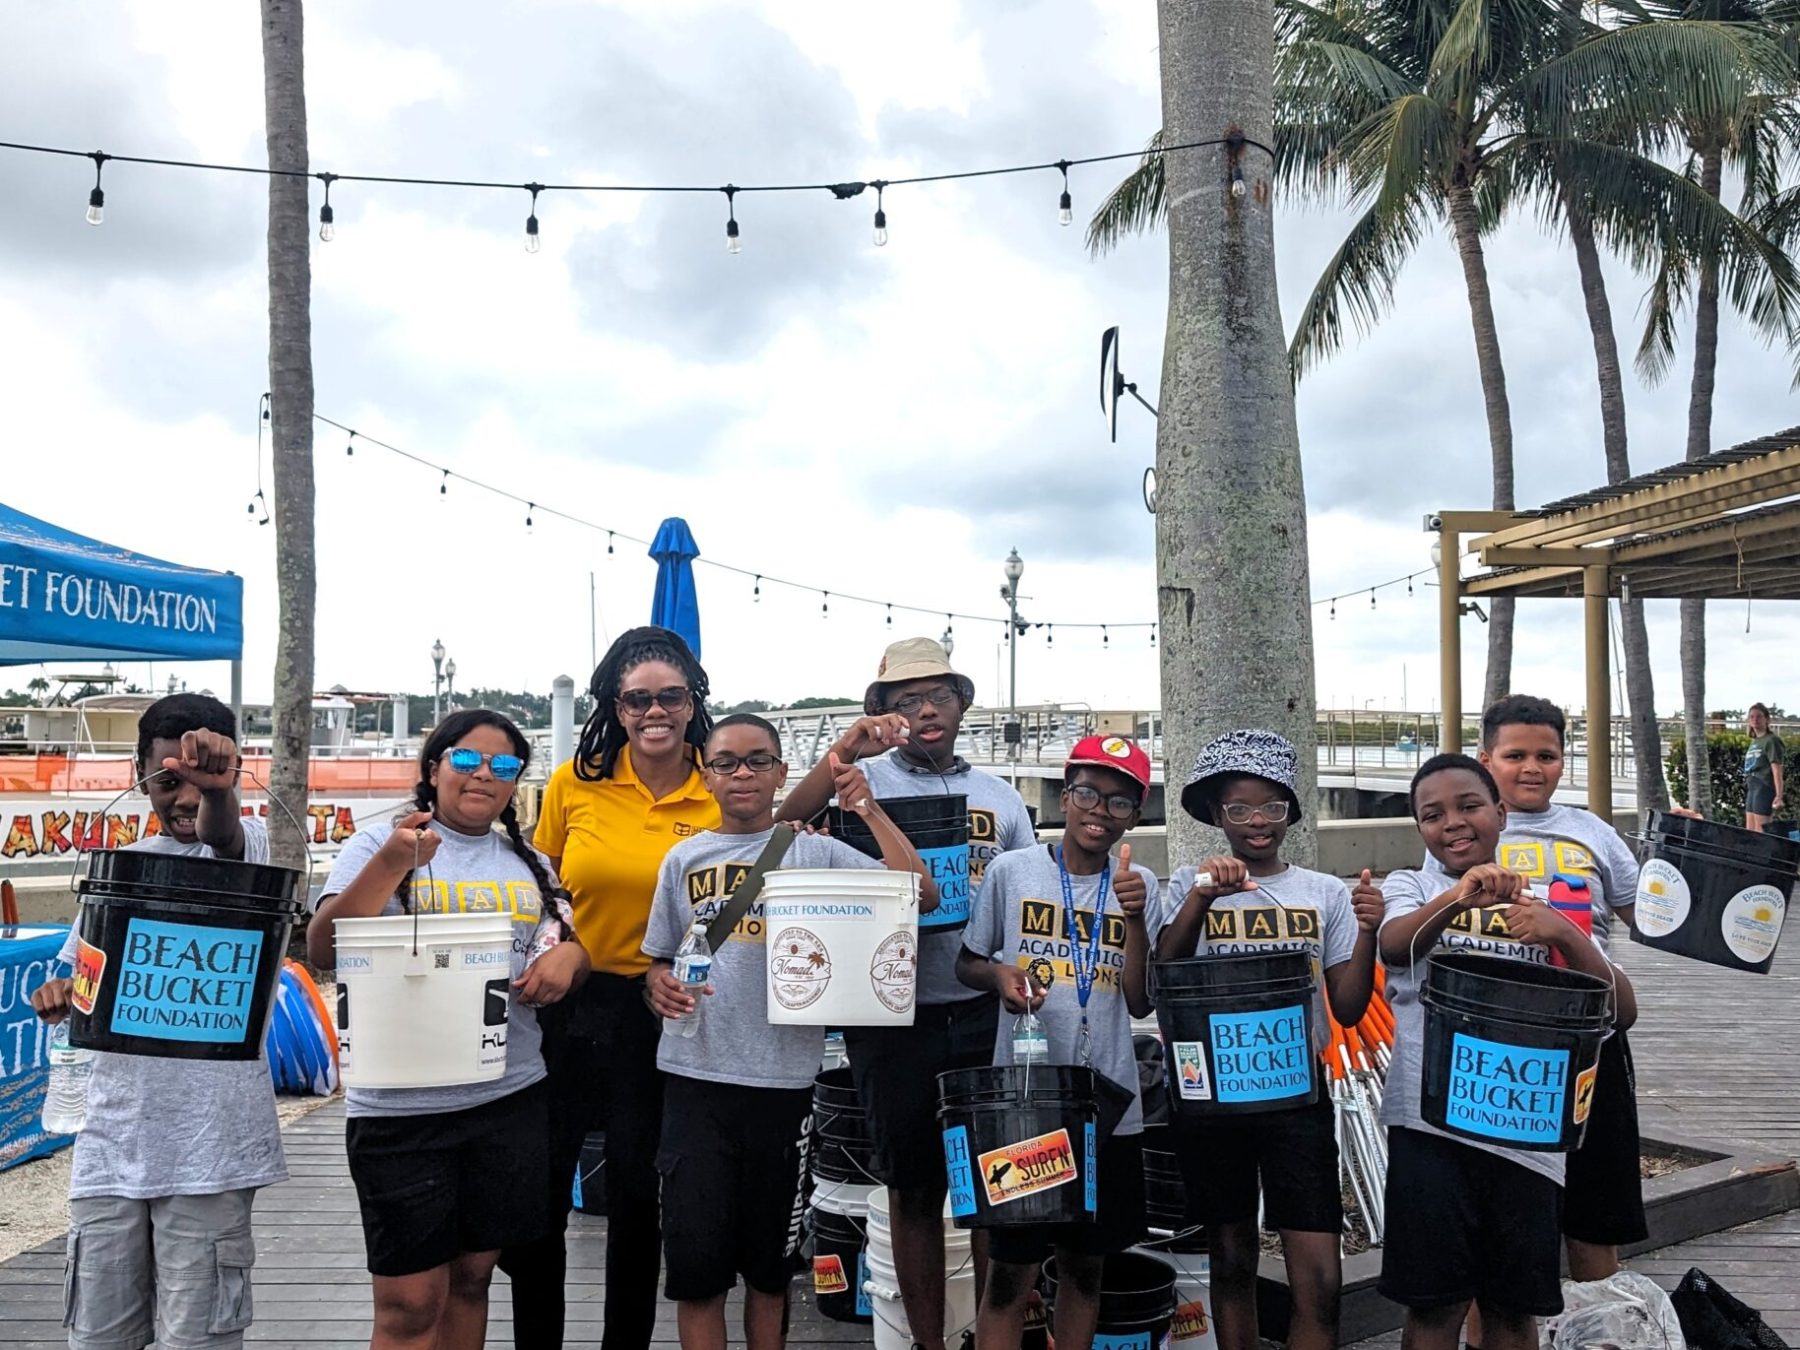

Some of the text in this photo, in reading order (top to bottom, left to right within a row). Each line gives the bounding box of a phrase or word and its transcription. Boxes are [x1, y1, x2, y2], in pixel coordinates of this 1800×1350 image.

[45, 570, 216, 634] FOUNDATION
[802, 904, 873, 916] FOUNDATION
[1207, 911, 1313, 936] MAD
[127, 931, 258, 975] BEACH
[464, 951, 497, 965] BEACH
[1018, 938, 1124, 968] ACADICS
[120, 970, 252, 1007] BUCKET
[1066, 963, 1121, 986] LONS
[116, 1003, 246, 1030] FOUNDATION
[1214, 1016, 1304, 1049] BEACH
[1216, 1046, 1305, 1075] BUCKET
[1456, 1044, 1565, 1087] BEACH
[1220, 1071, 1308, 1093] FOUNDATION
[1453, 1076, 1563, 1114] BUCKET
[1451, 1103, 1558, 1132] FOUNDATION
[1005, 1141, 1043, 1157] FLORIDA
[1016, 1144, 1071, 1181] SURFN
[1000, 1171, 1065, 1197] ENDLESS SUMMER
